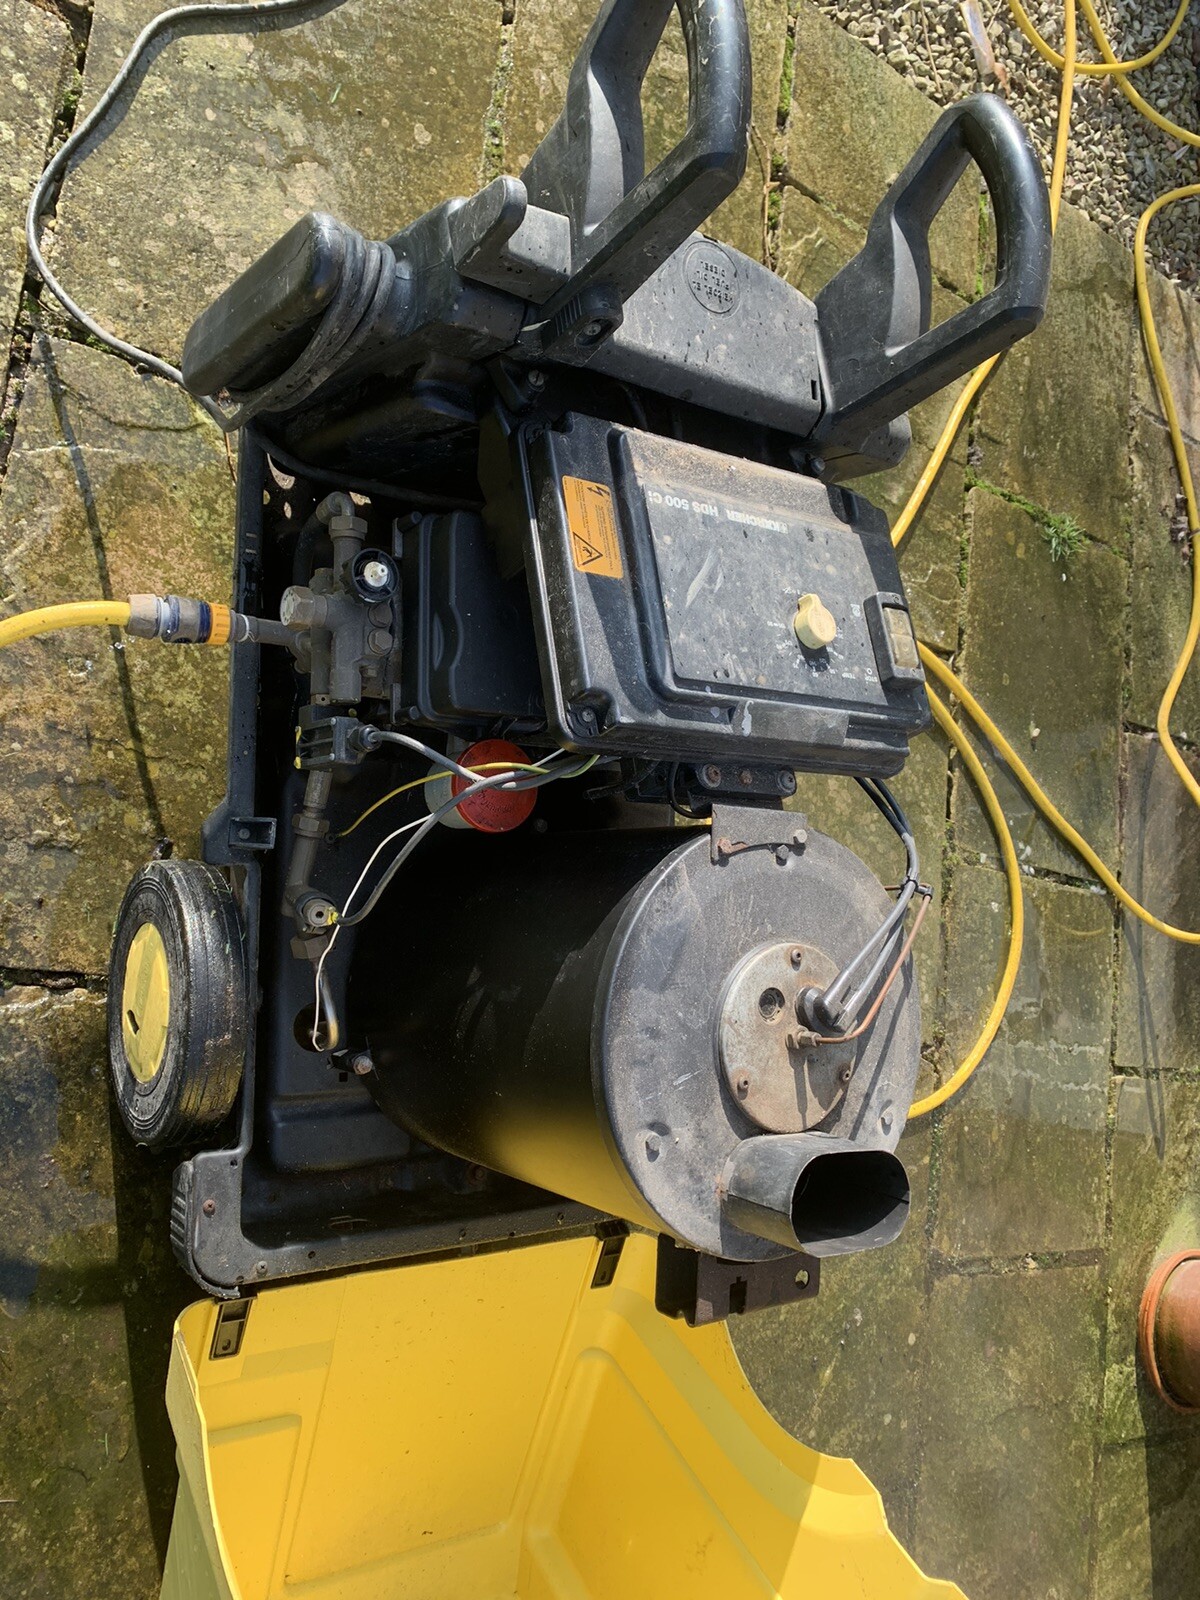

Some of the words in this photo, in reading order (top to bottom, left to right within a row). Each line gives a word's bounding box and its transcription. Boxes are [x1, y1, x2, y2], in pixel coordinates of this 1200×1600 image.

[700, 260, 725, 278] DIESEL
[664, 494, 690, 511] 500
[691, 501, 719, 517] HDS
